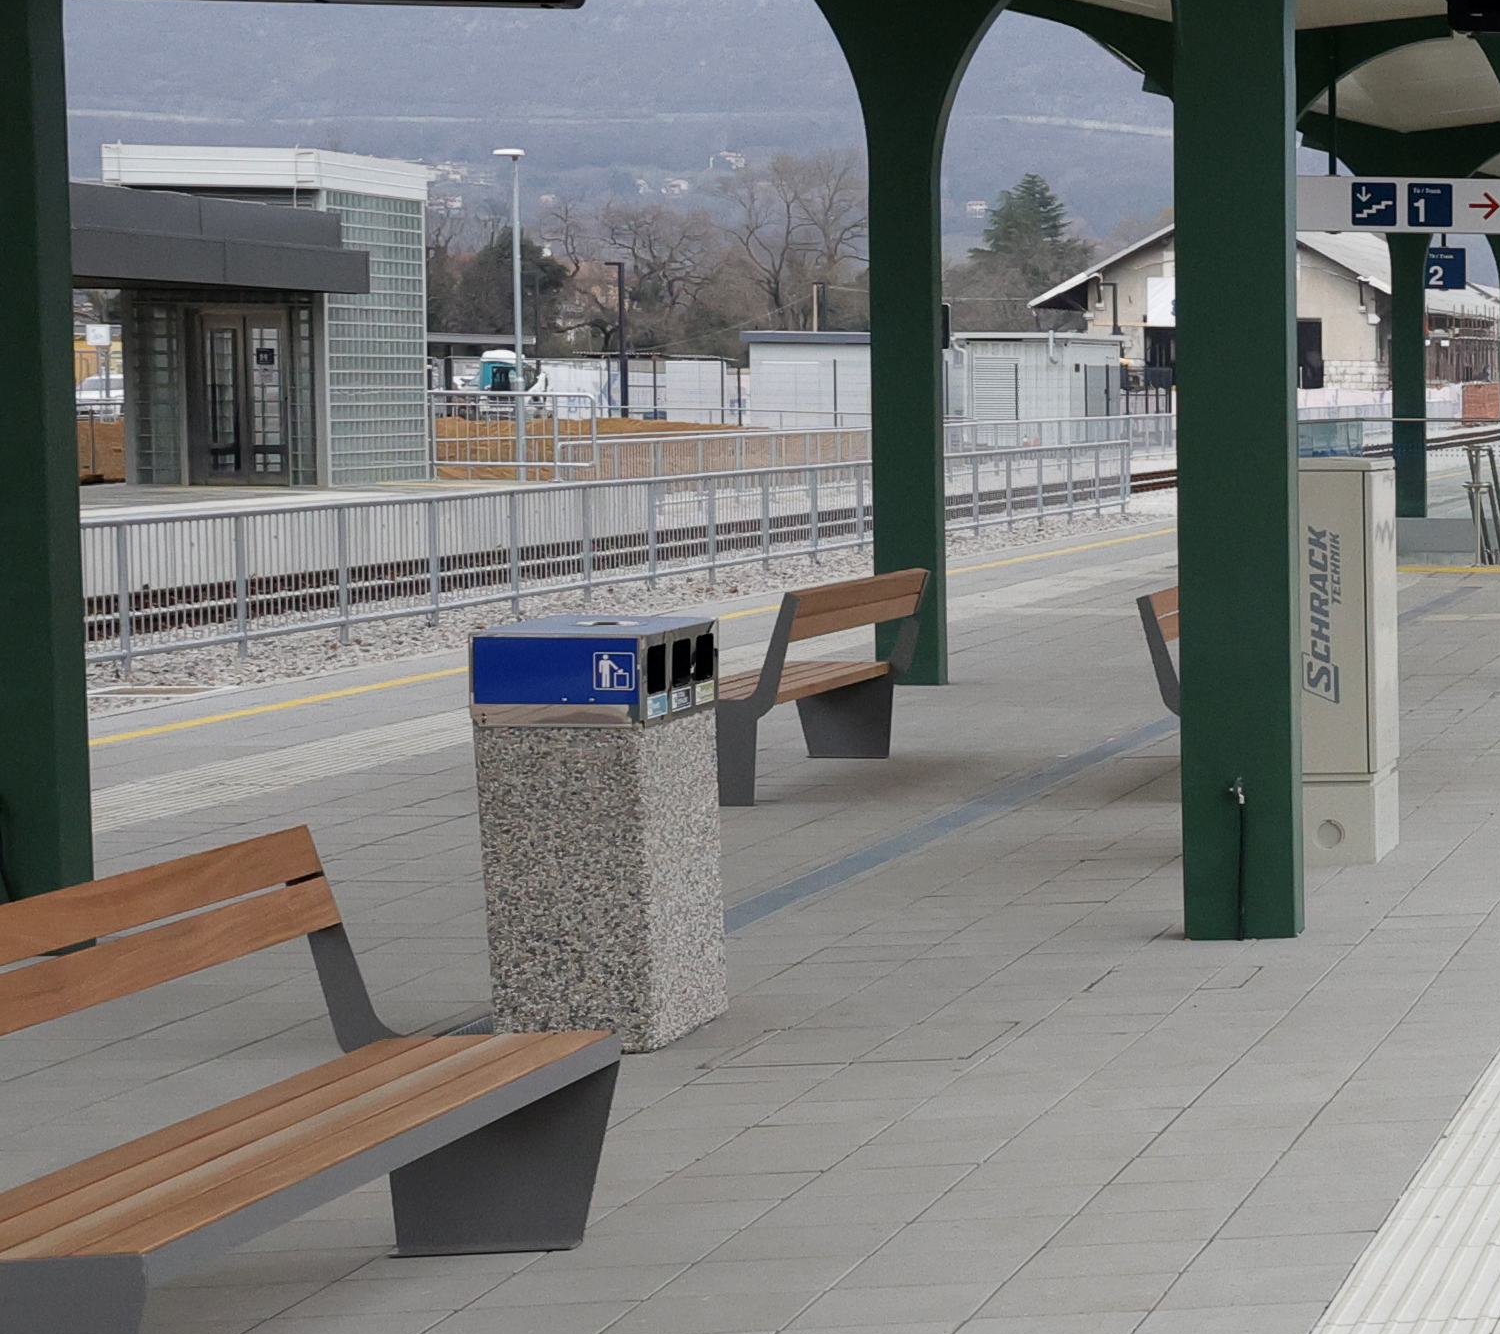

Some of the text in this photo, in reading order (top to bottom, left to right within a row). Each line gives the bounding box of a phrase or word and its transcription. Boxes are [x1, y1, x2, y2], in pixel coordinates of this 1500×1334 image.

[1413, 198, 1425, 223] 1
[1428, 265, 1444, 286] 2
[1329, 531, 1342, 606] TECHNIK
[1306, 524, 1332, 694] SCHRACK
